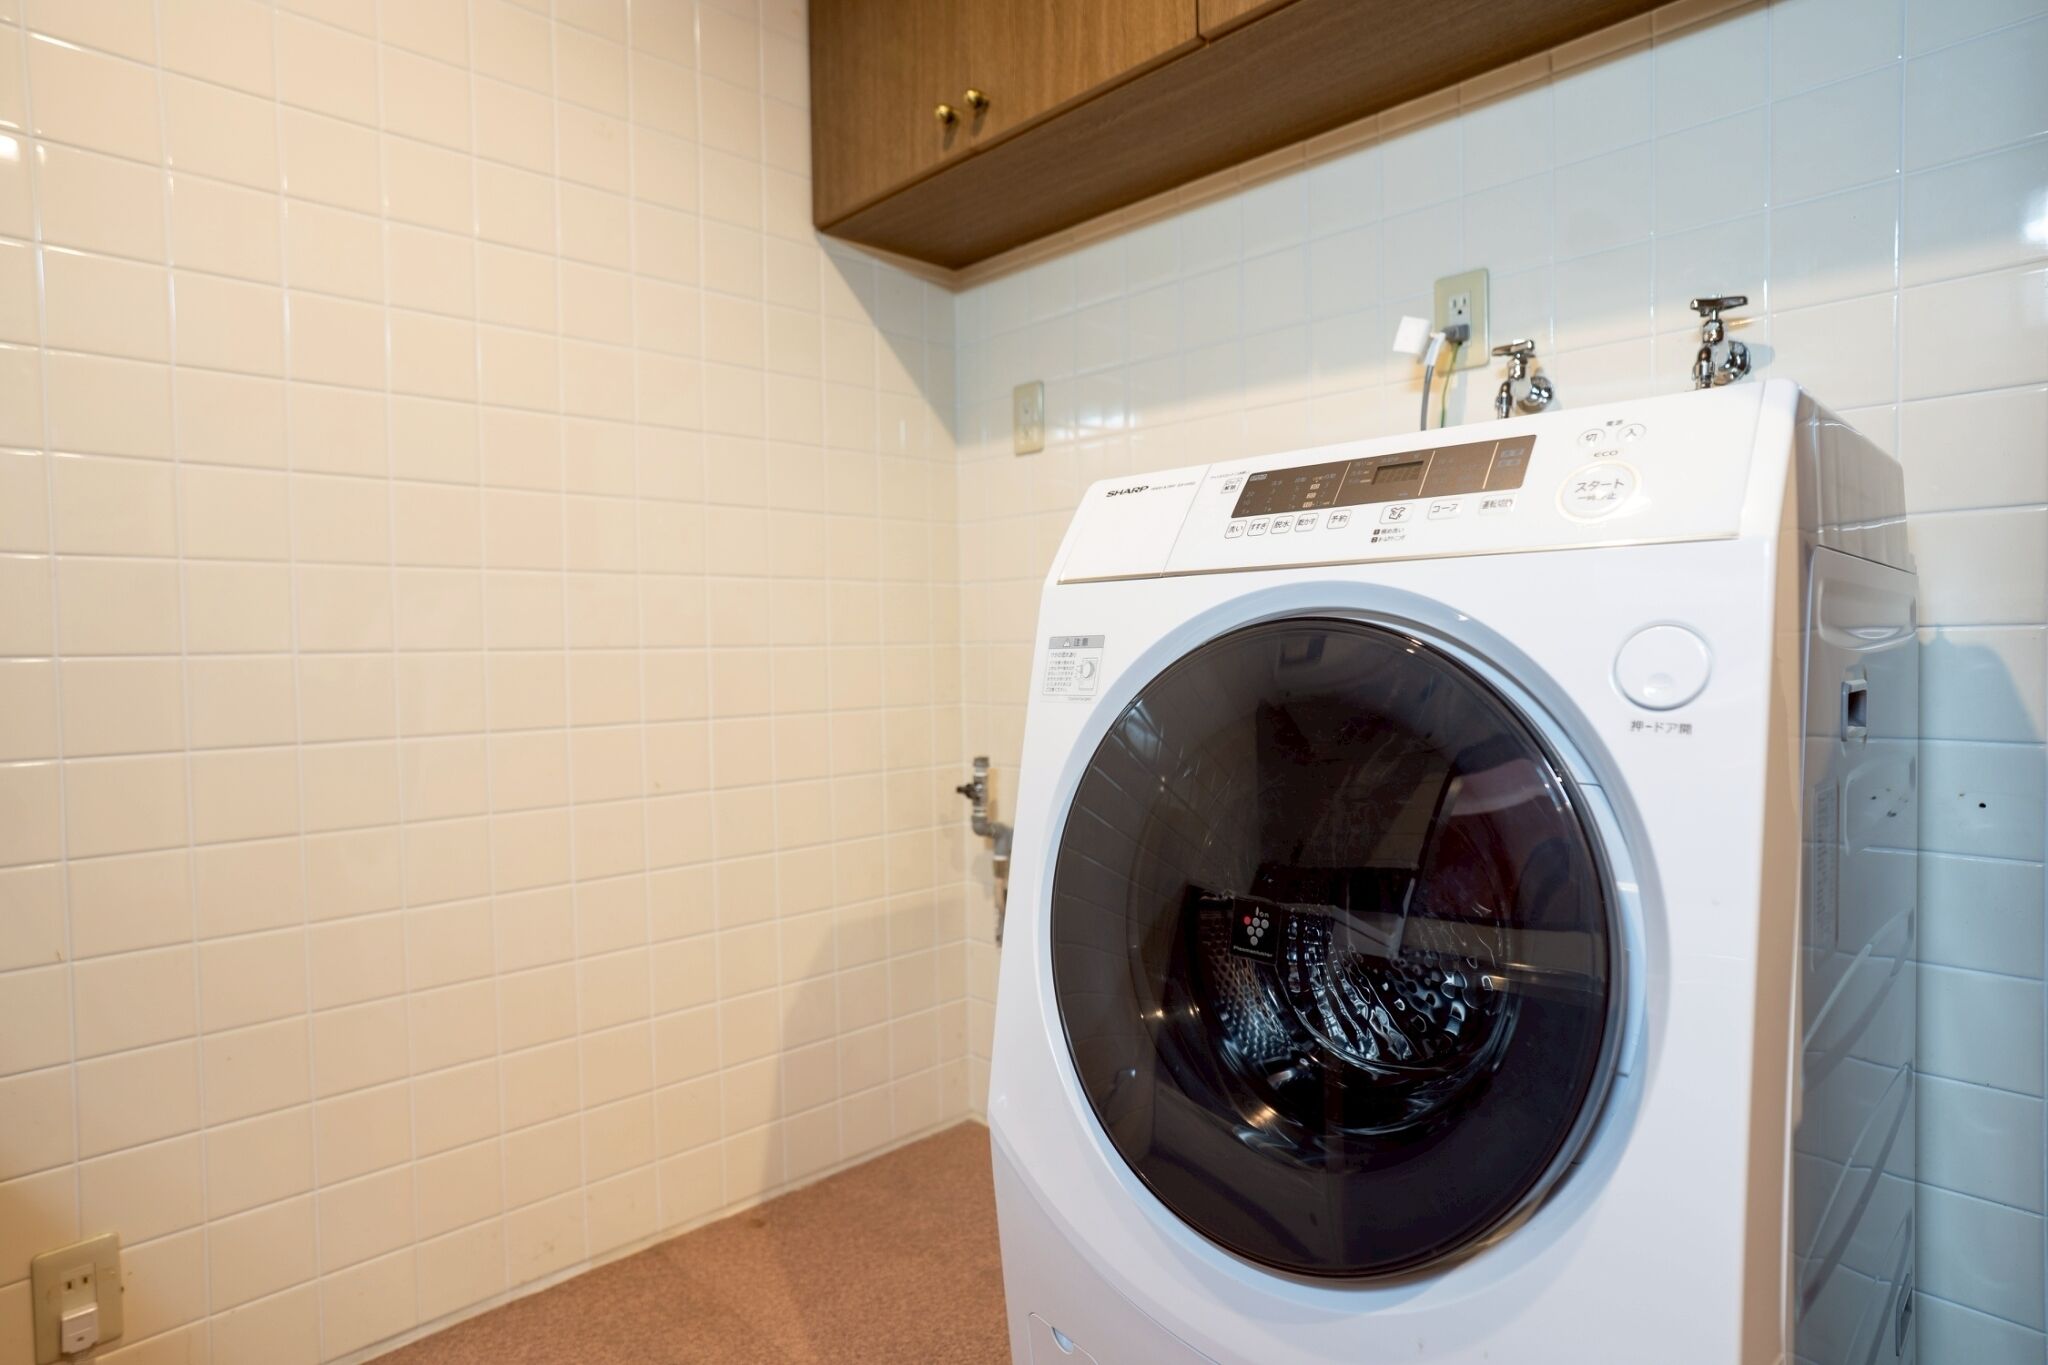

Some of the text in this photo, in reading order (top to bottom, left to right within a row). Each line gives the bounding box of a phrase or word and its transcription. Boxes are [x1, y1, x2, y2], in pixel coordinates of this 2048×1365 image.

[1625, 428, 1637, 438] 入
[1575, 478, 1625, 494] スタート
[1106, 485, 1149, 498] SHARP
[1431, 503, 1459, 513] コース
[1331, 514, 1348, 524] 予約
[1274, 520, 1290, 529] 脱水
